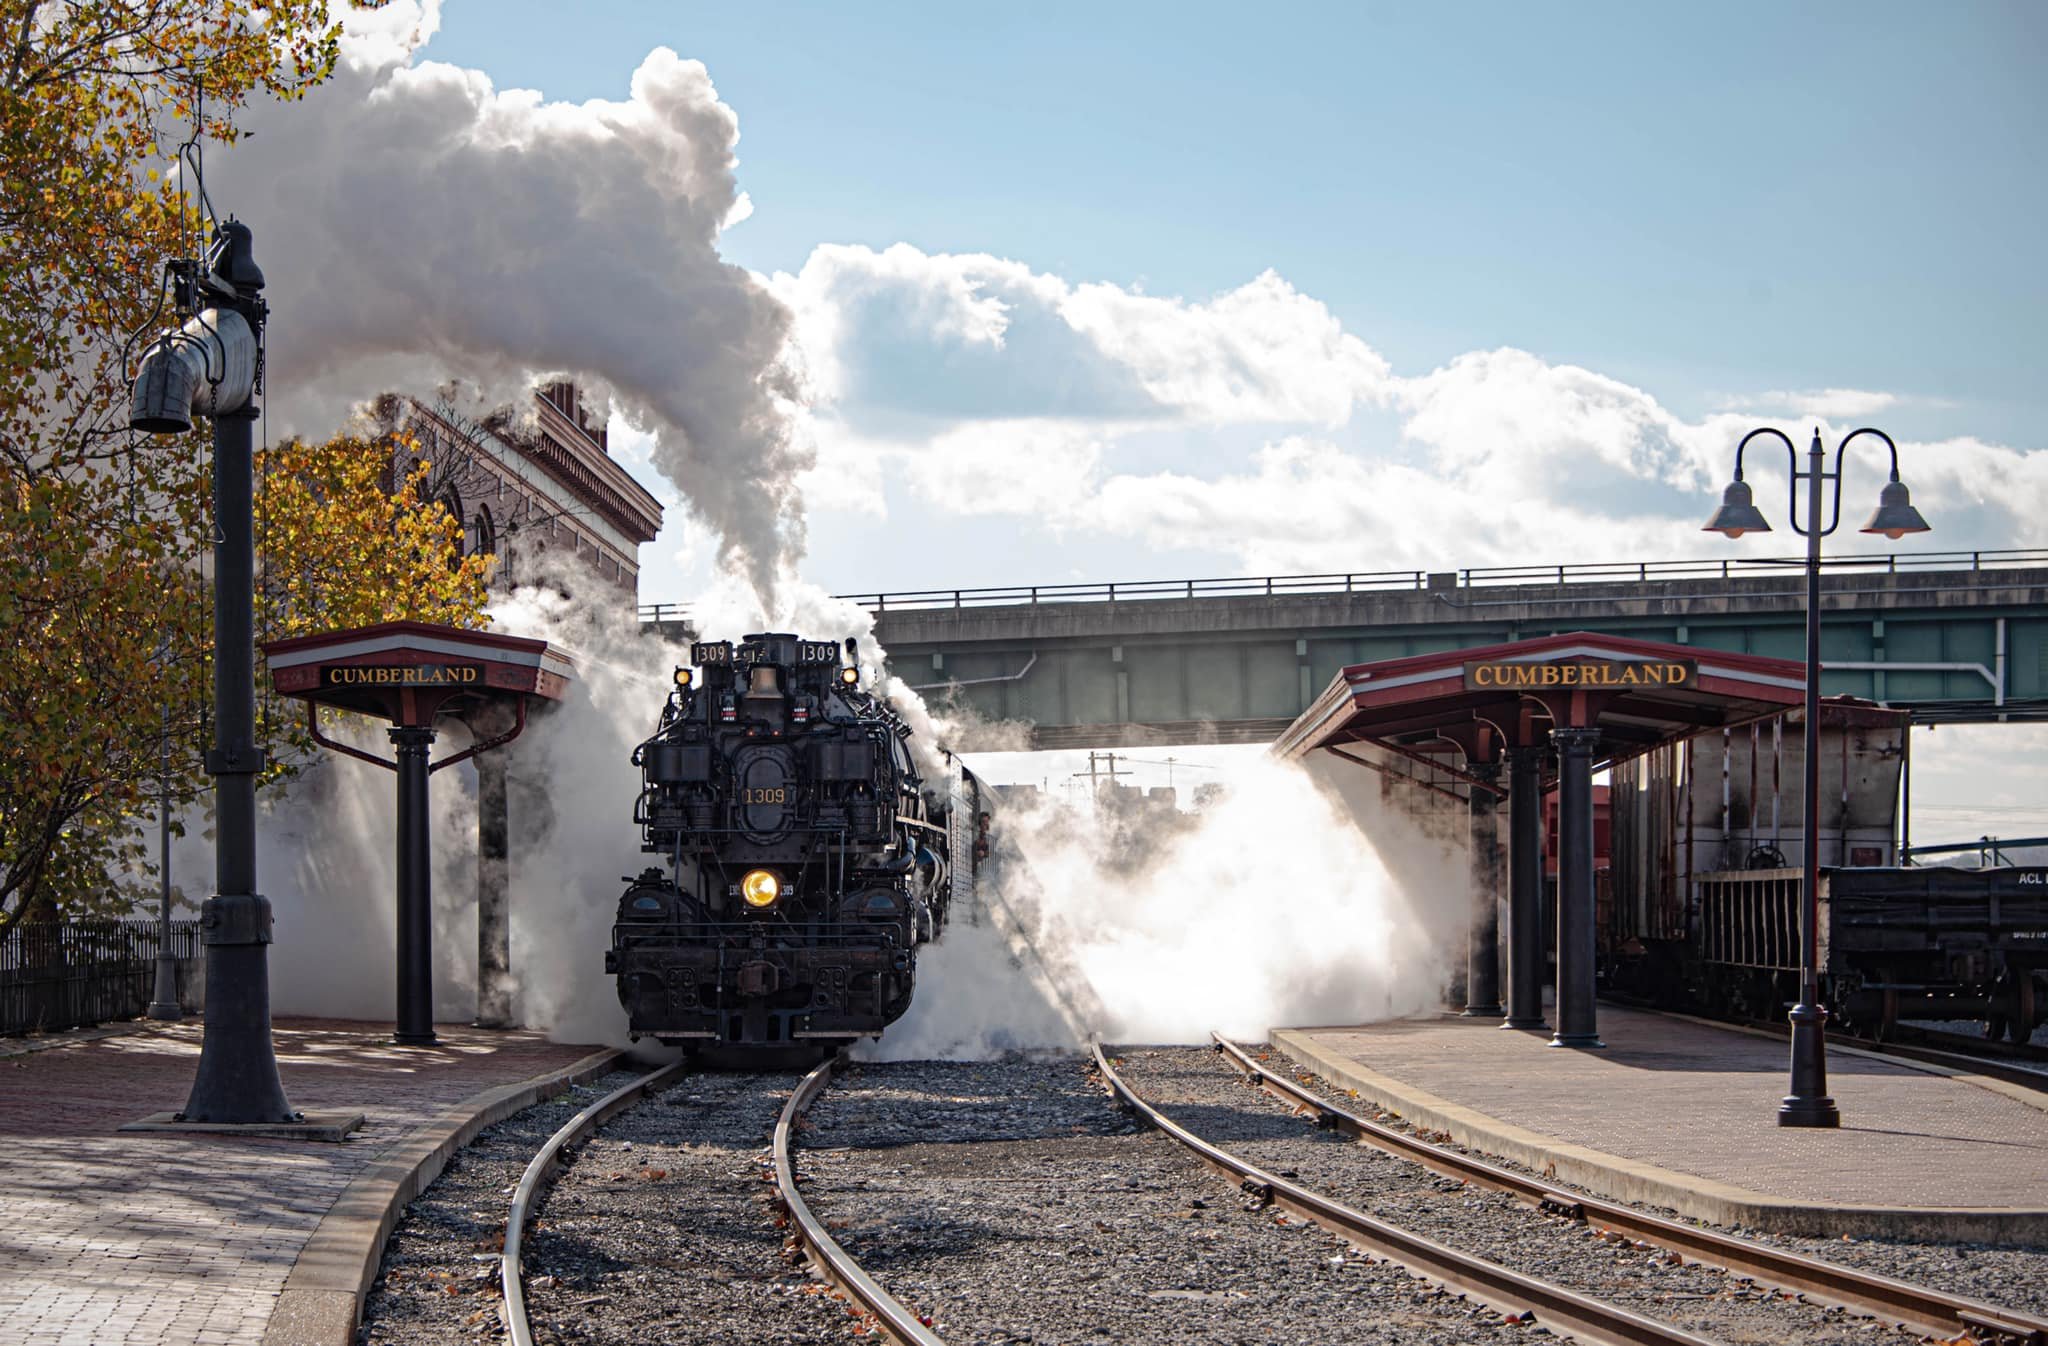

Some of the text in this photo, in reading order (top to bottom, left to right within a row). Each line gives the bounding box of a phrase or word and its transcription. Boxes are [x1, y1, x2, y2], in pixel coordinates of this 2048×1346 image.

[696, 645, 725, 662] 1309
[802, 644, 834, 662] 1309
[330, 667, 476, 683] CUMBERLAND
[1474, 664, 1687, 686] CUMBERLAND
[745, 788, 785, 804] 1309
[2018, 872, 2043, 885] ACL
